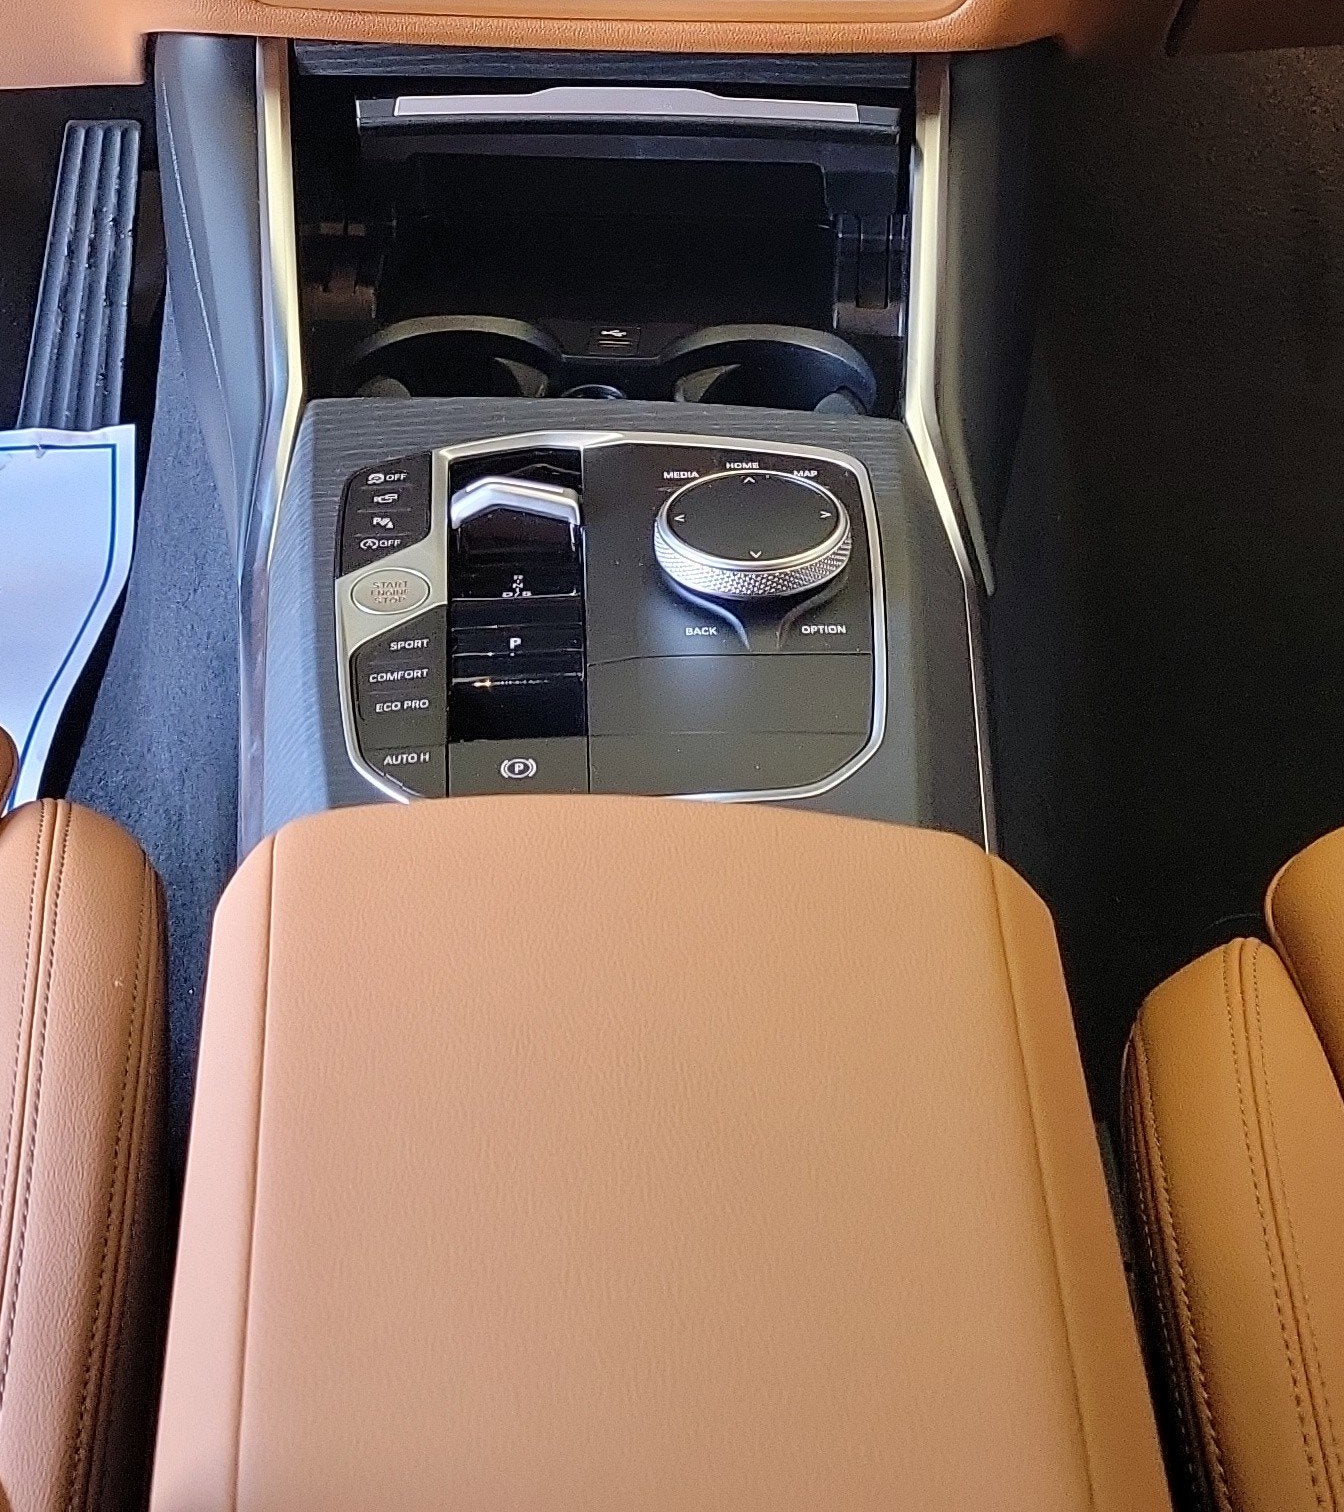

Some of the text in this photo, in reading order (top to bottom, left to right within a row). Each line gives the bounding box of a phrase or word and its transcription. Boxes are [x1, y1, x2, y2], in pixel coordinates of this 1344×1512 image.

[386, 473, 407, 481] OFF
[663, 471, 700, 479] MEDIA
[794, 470, 818, 478] MAP
[379, 539, 401, 547] OFF
[373, 581, 408, 589] START
[686, 627, 717, 636] BACK
[802, 625, 846, 634] OPTION
[390, 639, 430, 651] SPORT
[369, 669, 429, 683] COMFORT
[376, 699, 429, 713] ECO PRO
[383, 752, 430, 765] AUTO H
